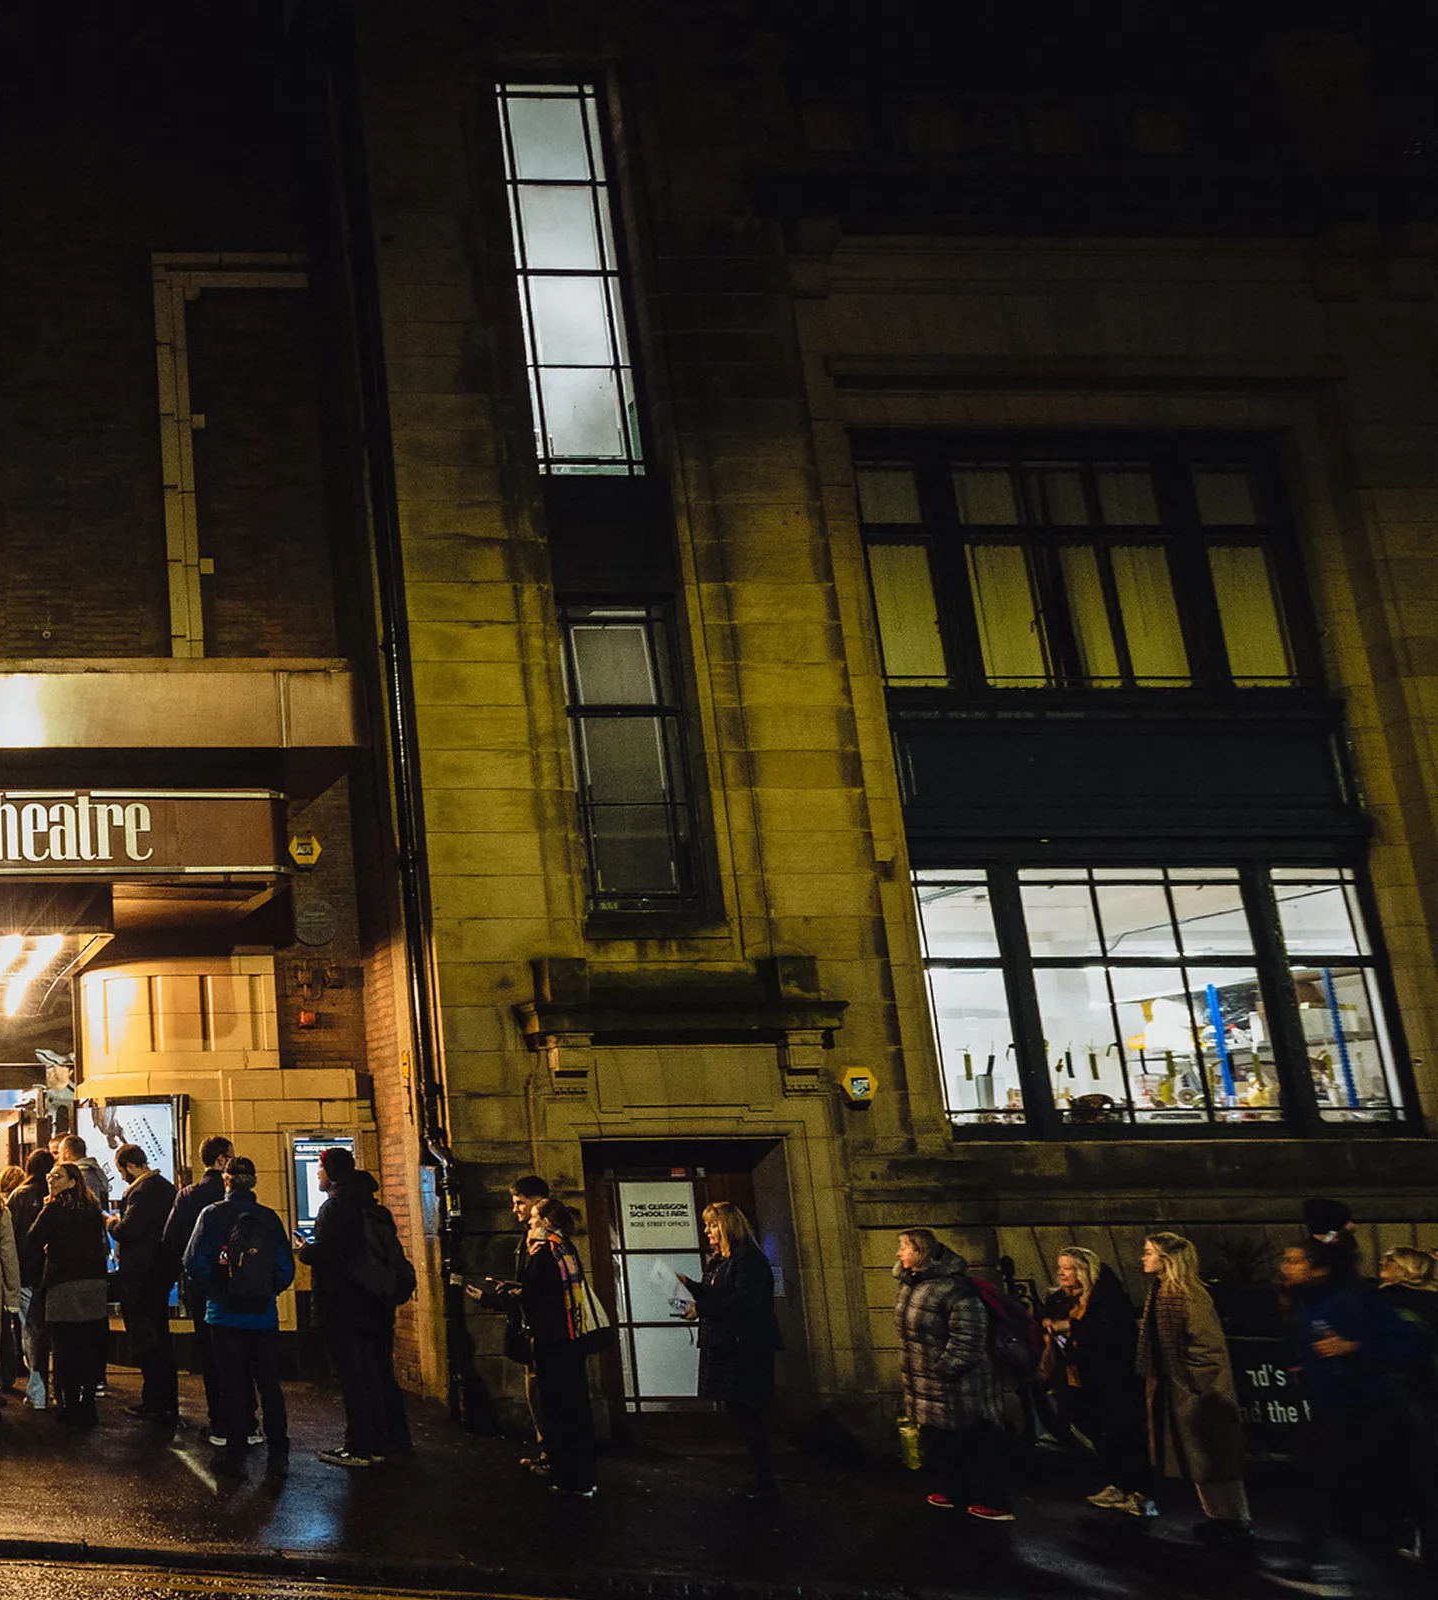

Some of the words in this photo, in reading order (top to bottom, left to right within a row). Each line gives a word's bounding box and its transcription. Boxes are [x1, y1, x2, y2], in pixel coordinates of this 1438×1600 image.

[629, 1203, 647, 1211] THE
[647, 1203, 689, 1211] GLASGOW
[1267, 1400, 1299, 1423] the
